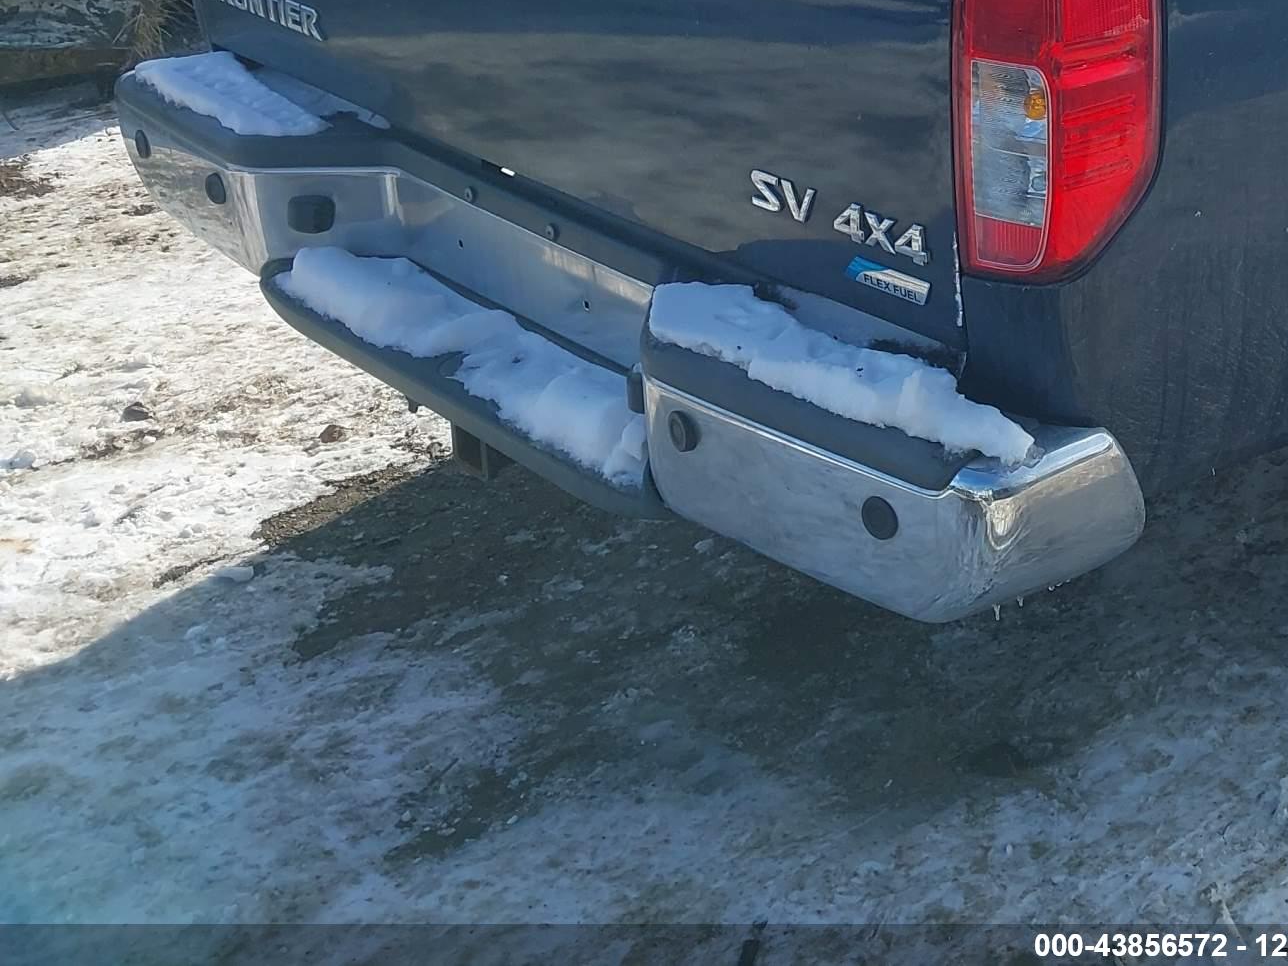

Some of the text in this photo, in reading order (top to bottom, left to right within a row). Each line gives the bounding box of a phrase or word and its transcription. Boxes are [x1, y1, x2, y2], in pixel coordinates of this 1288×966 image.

[750, 168, 816, 224] SV
[863, 273, 922, 303] FLEX FUEL
